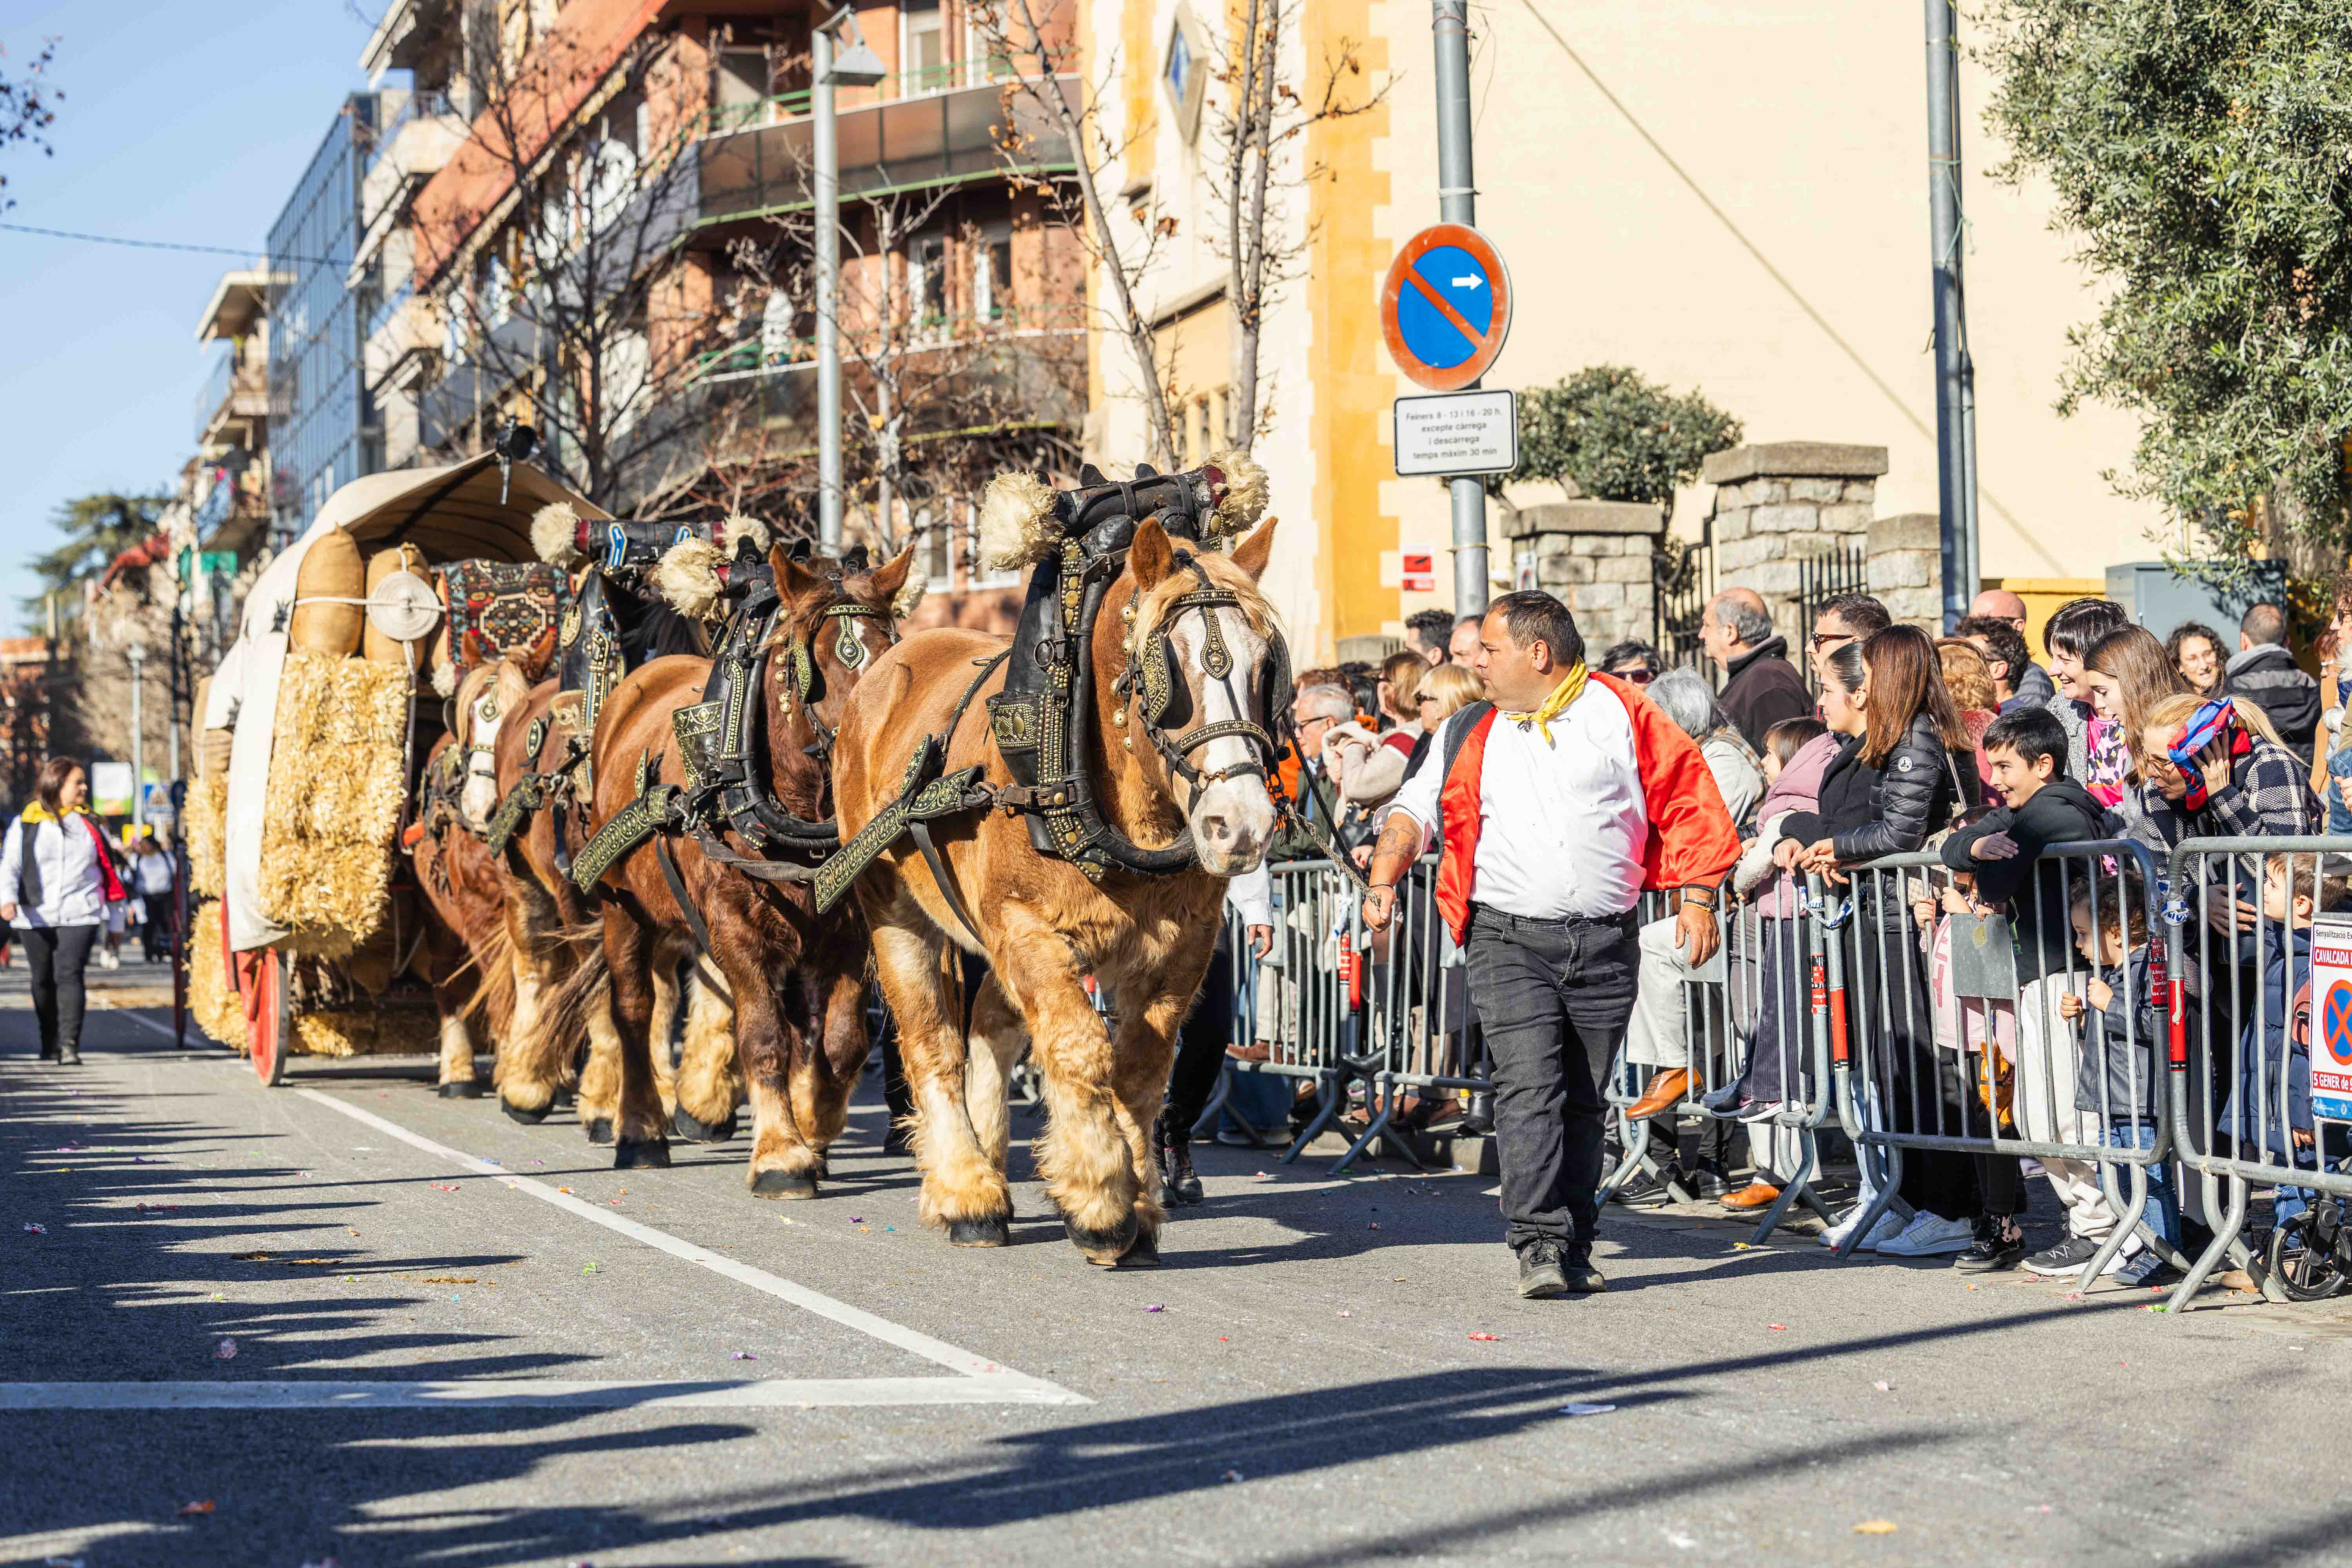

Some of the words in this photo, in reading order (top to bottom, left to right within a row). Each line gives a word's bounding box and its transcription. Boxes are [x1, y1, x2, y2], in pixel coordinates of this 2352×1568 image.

[1406, 412, 1434, 421] Feiners
[1436, 410, 1442, 419] 8
[1450, 410, 1459, 419] 13
[1483, 407, 1493, 416] 20
[1421, 423, 1452, 432] excepte
[1455, 421, 1487, 432] càrrega
[1434, 436, 1480, 445] descàrrega
[1413, 452, 1438, 461] temps
[1470, 448, 1480, 456] 30
[1482, 446, 1497, 456] min
[2315, 929, 2346, 940] Senyalització
[2315, 949, 2349, 965] CAVALCADA
[2314, 1073, 2318, 1086] 5
[2319, 1074, 2340, 1089] GENER
[2341, 1076, 2349, 1090] de
